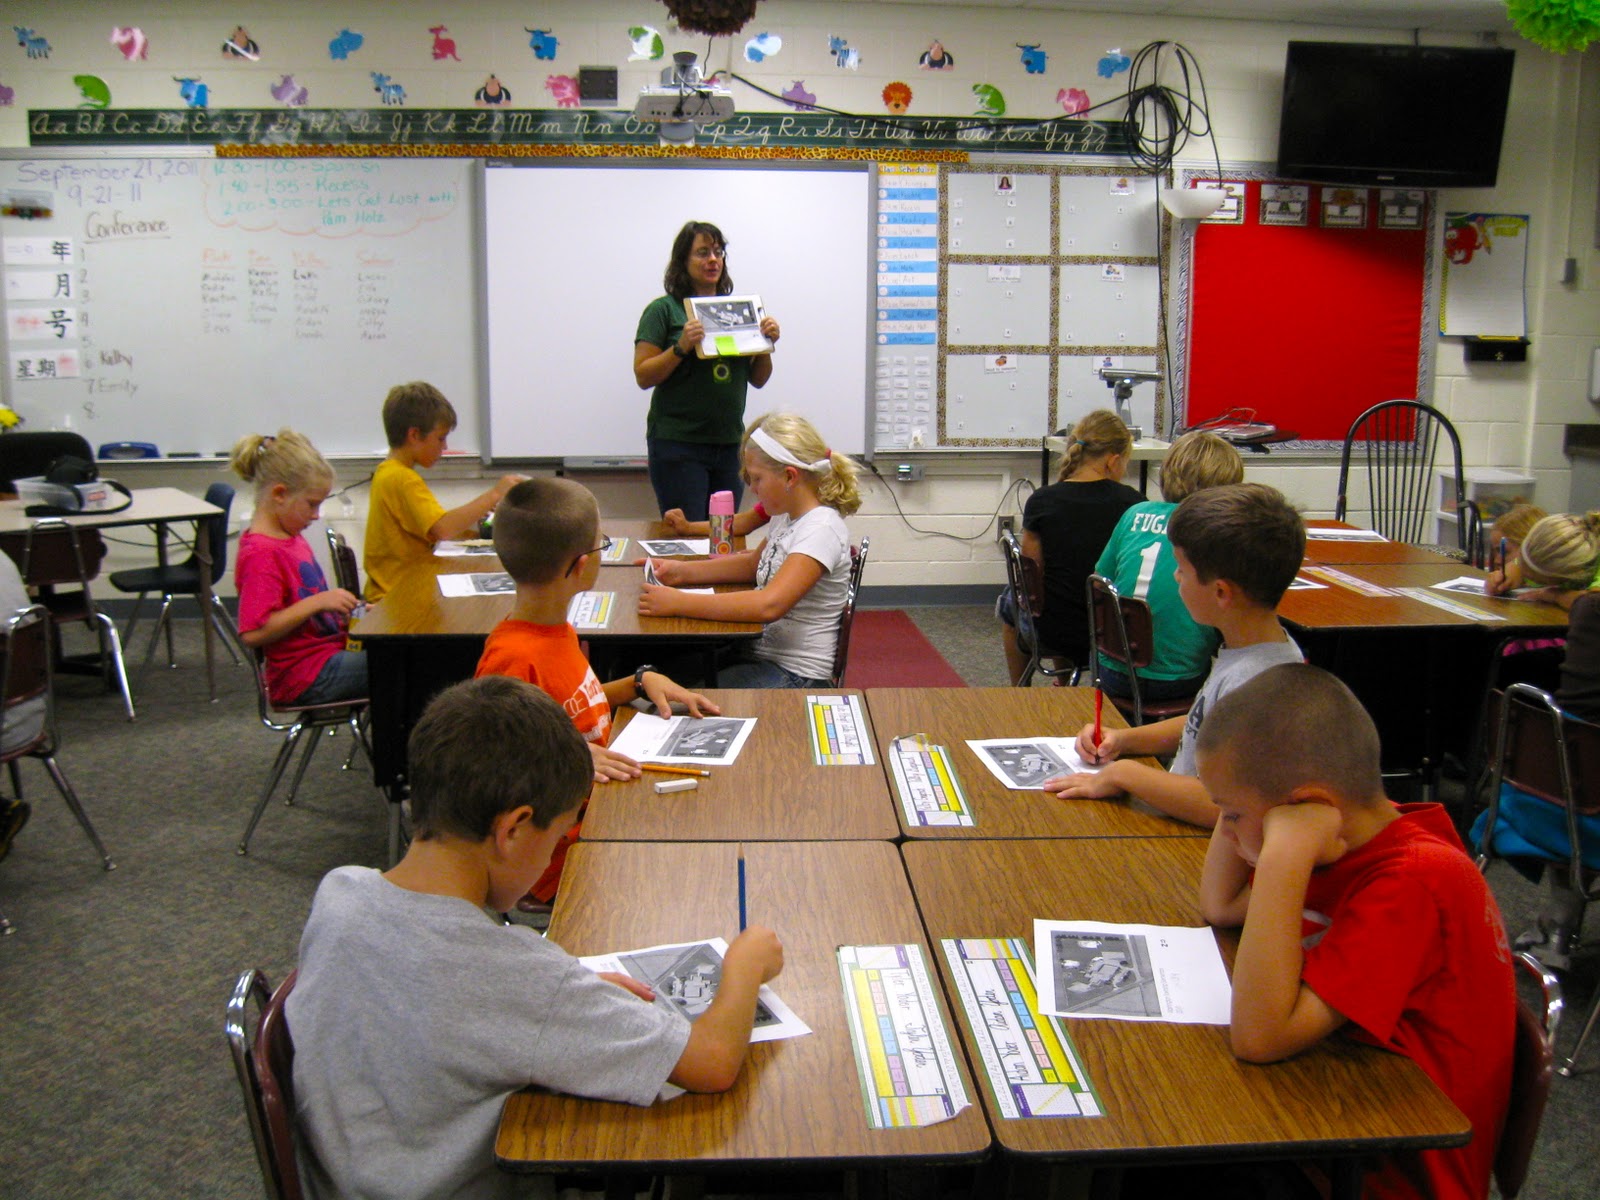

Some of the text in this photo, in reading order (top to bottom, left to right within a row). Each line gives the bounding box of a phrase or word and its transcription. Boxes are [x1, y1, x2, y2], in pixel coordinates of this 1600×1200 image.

[18, 161, 131, 189] September
[86, 210, 170, 239] Conference
[54, 272, 71, 298] 月
[45, 309, 73, 339] 号
[1133, 541, 1162, 601] 1
